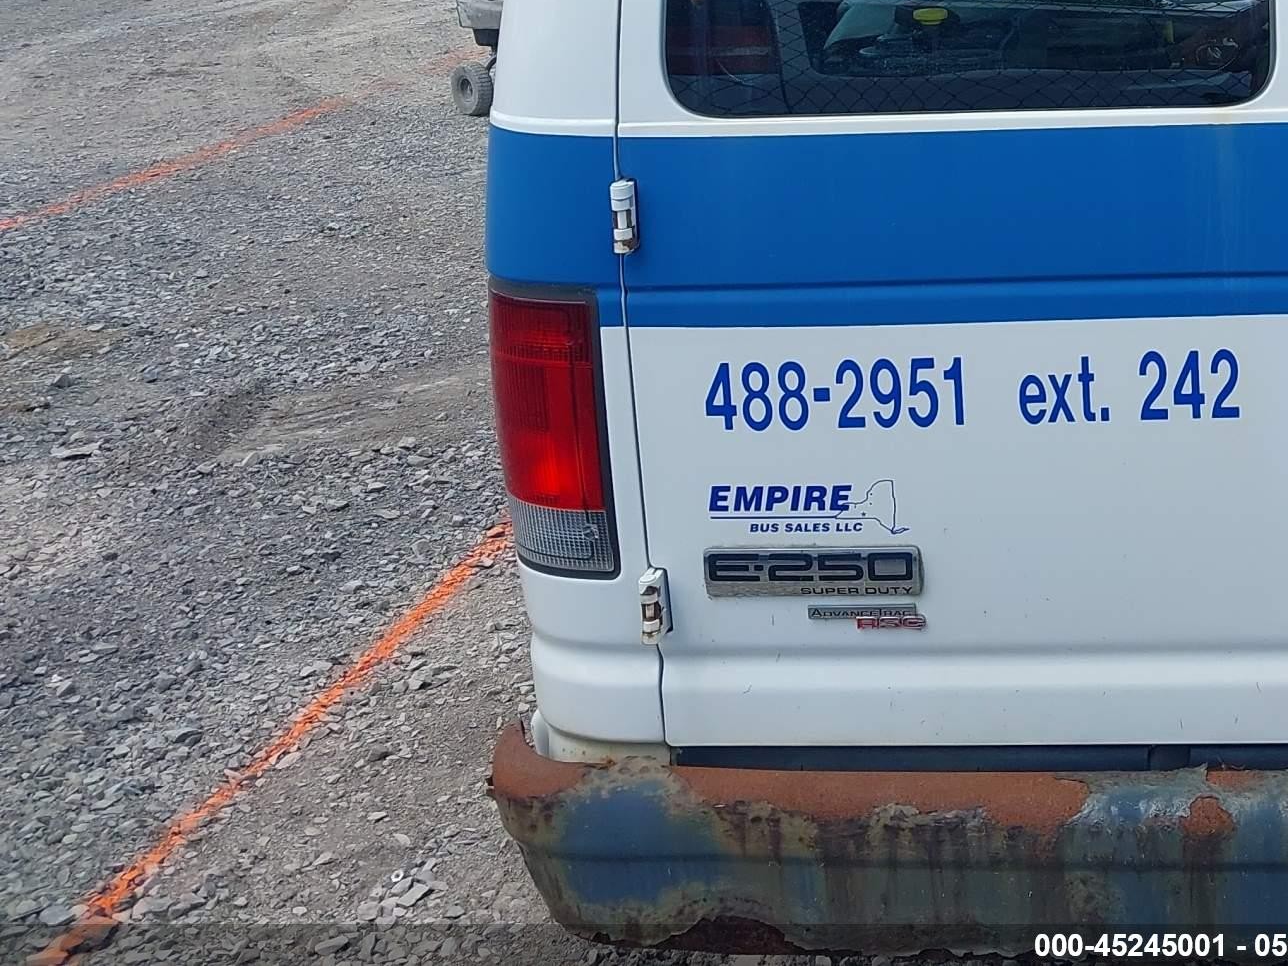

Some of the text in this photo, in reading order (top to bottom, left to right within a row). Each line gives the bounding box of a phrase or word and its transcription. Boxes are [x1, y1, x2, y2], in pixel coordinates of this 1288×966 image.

[705, 348, 1241, 432] 488-2951 ext. 242
[709, 484, 853, 513] EMPIRE
[749, 522, 864, 533] BUS SALES LLC
[708, 552, 914, 583] E-250
[800, 586, 913, 596] SUPER DUTY
